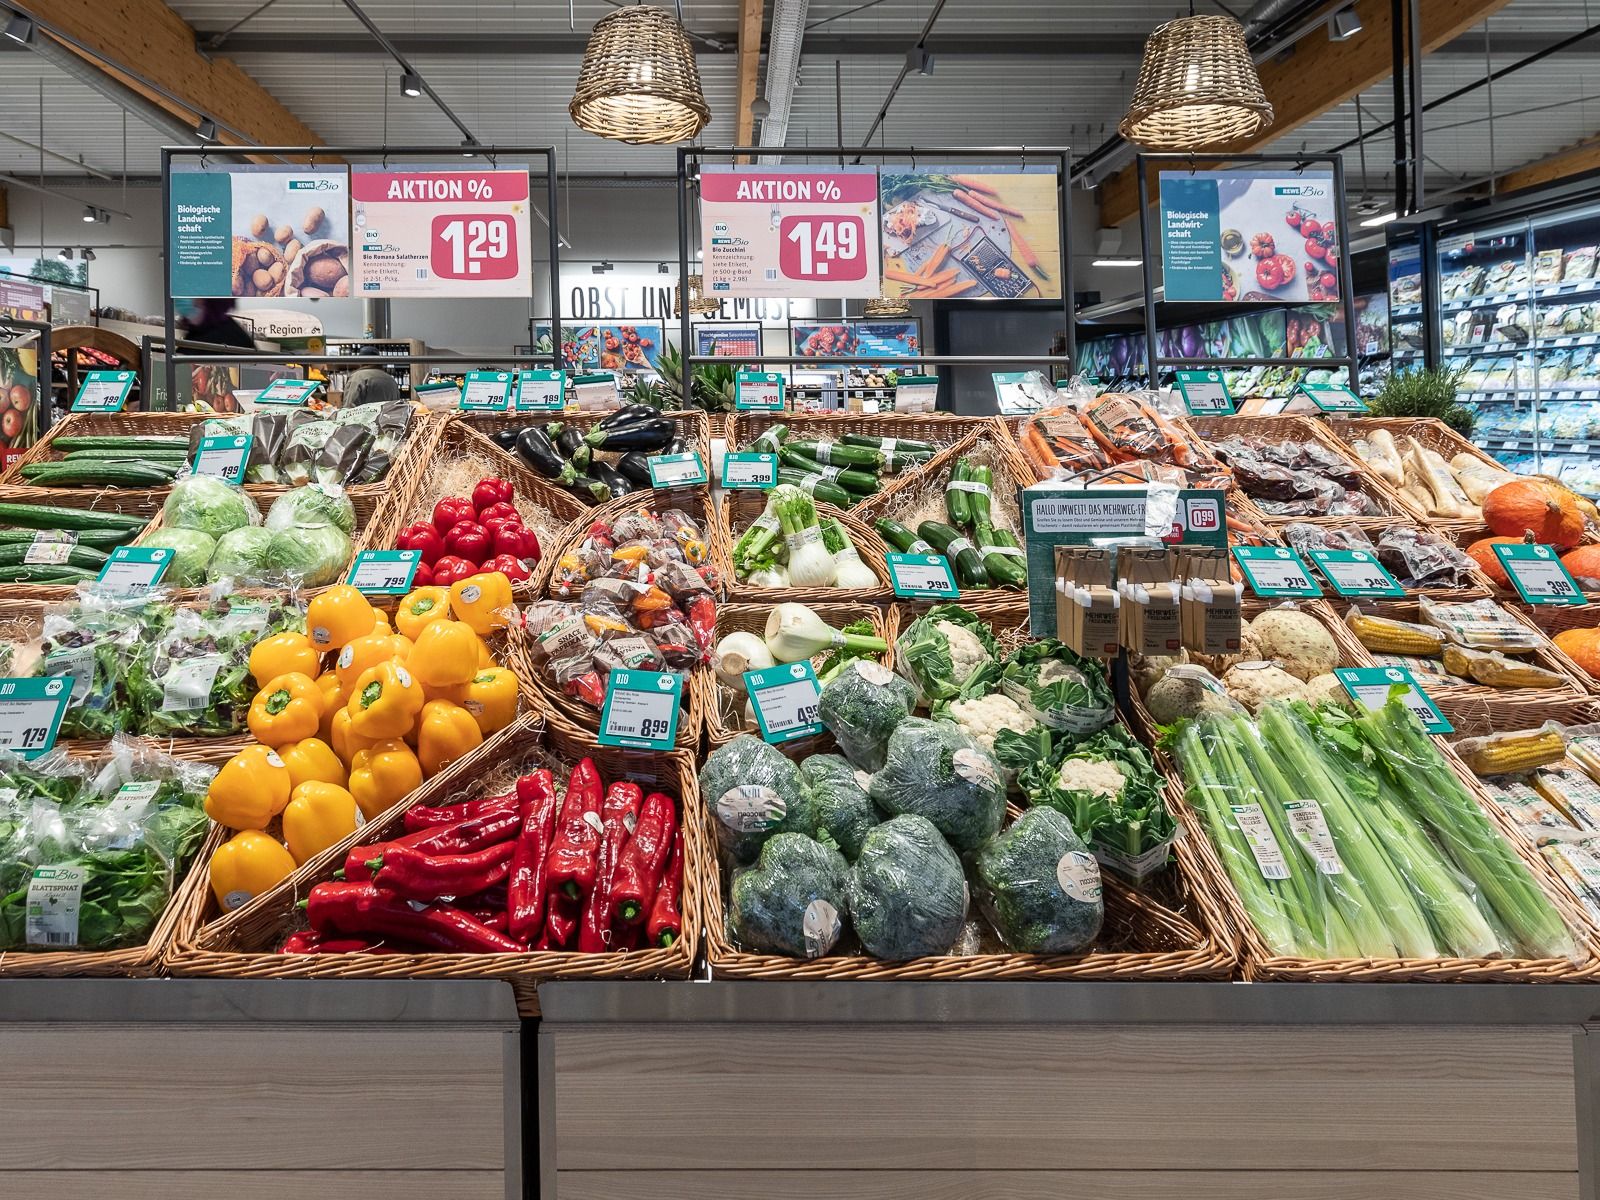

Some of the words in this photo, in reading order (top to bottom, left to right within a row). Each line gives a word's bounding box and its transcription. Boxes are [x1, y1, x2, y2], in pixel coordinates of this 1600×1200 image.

[316, 181, 339, 191] Bio
[387, 179, 462, 199] AKTION
[468, 179, 493, 199] %
[736, 180, 811, 200] AKTION
[816, 180, 841, 200] %
[1300, 186, 1324, 197] Bio
[177, 205, 221, 215] Biologische
[1167, 210, 1209, 220] Biologische
[177, 214, 215, 223] Landwirt-
[1167, 220, 1203, 228] Landwirt-
[177, 224, 202, 232] schaft
[1167, 230, 1191, 238] schaft
[440, 220, 508, 273] 1.29
[787, 221, 857, 275] 1.49
[571, 286, 629, 318] OBST
[642, 286, 681, 319] UN
[270, 324, 303, 336] Region
[487, 395, 503, 404] 7.99
[1210, 398, 1226, 409] 1.79
[221, 465, 240, 478] 1.99
[751, 475, 771, 483] 3.99
[1036, 504, 1056, 516] HALLO
[1057, 504, 1087, 516] UMWELT!
[1088, 504, 1102, 515] DAS
[1103, 504, 1147, 515] MEHRWEG-FR
[1193, 510, 1214, 526] 0.99
[382, 577, 406, 588] 7.99
[1283, 577, 1307, 589] 2.79
[1364, 578, 1390, 589] 2.49
[1547, 580, 1572, 595] 3.99
[557, 628, 582, 645] SNACK
[551, 635, 582, 657] PAPRIKA
[615, 673, 629, 685] BIO
[750, 674, 765, 686] BIO
[1, 683, 15, 695] BIO
[640, 718, 669, 737] 8.99
[22, 727, 48, 747] 1.79
[55, 869, 79, 880] Bio
[31, 884, 79, 892] BLATTSPINAT
